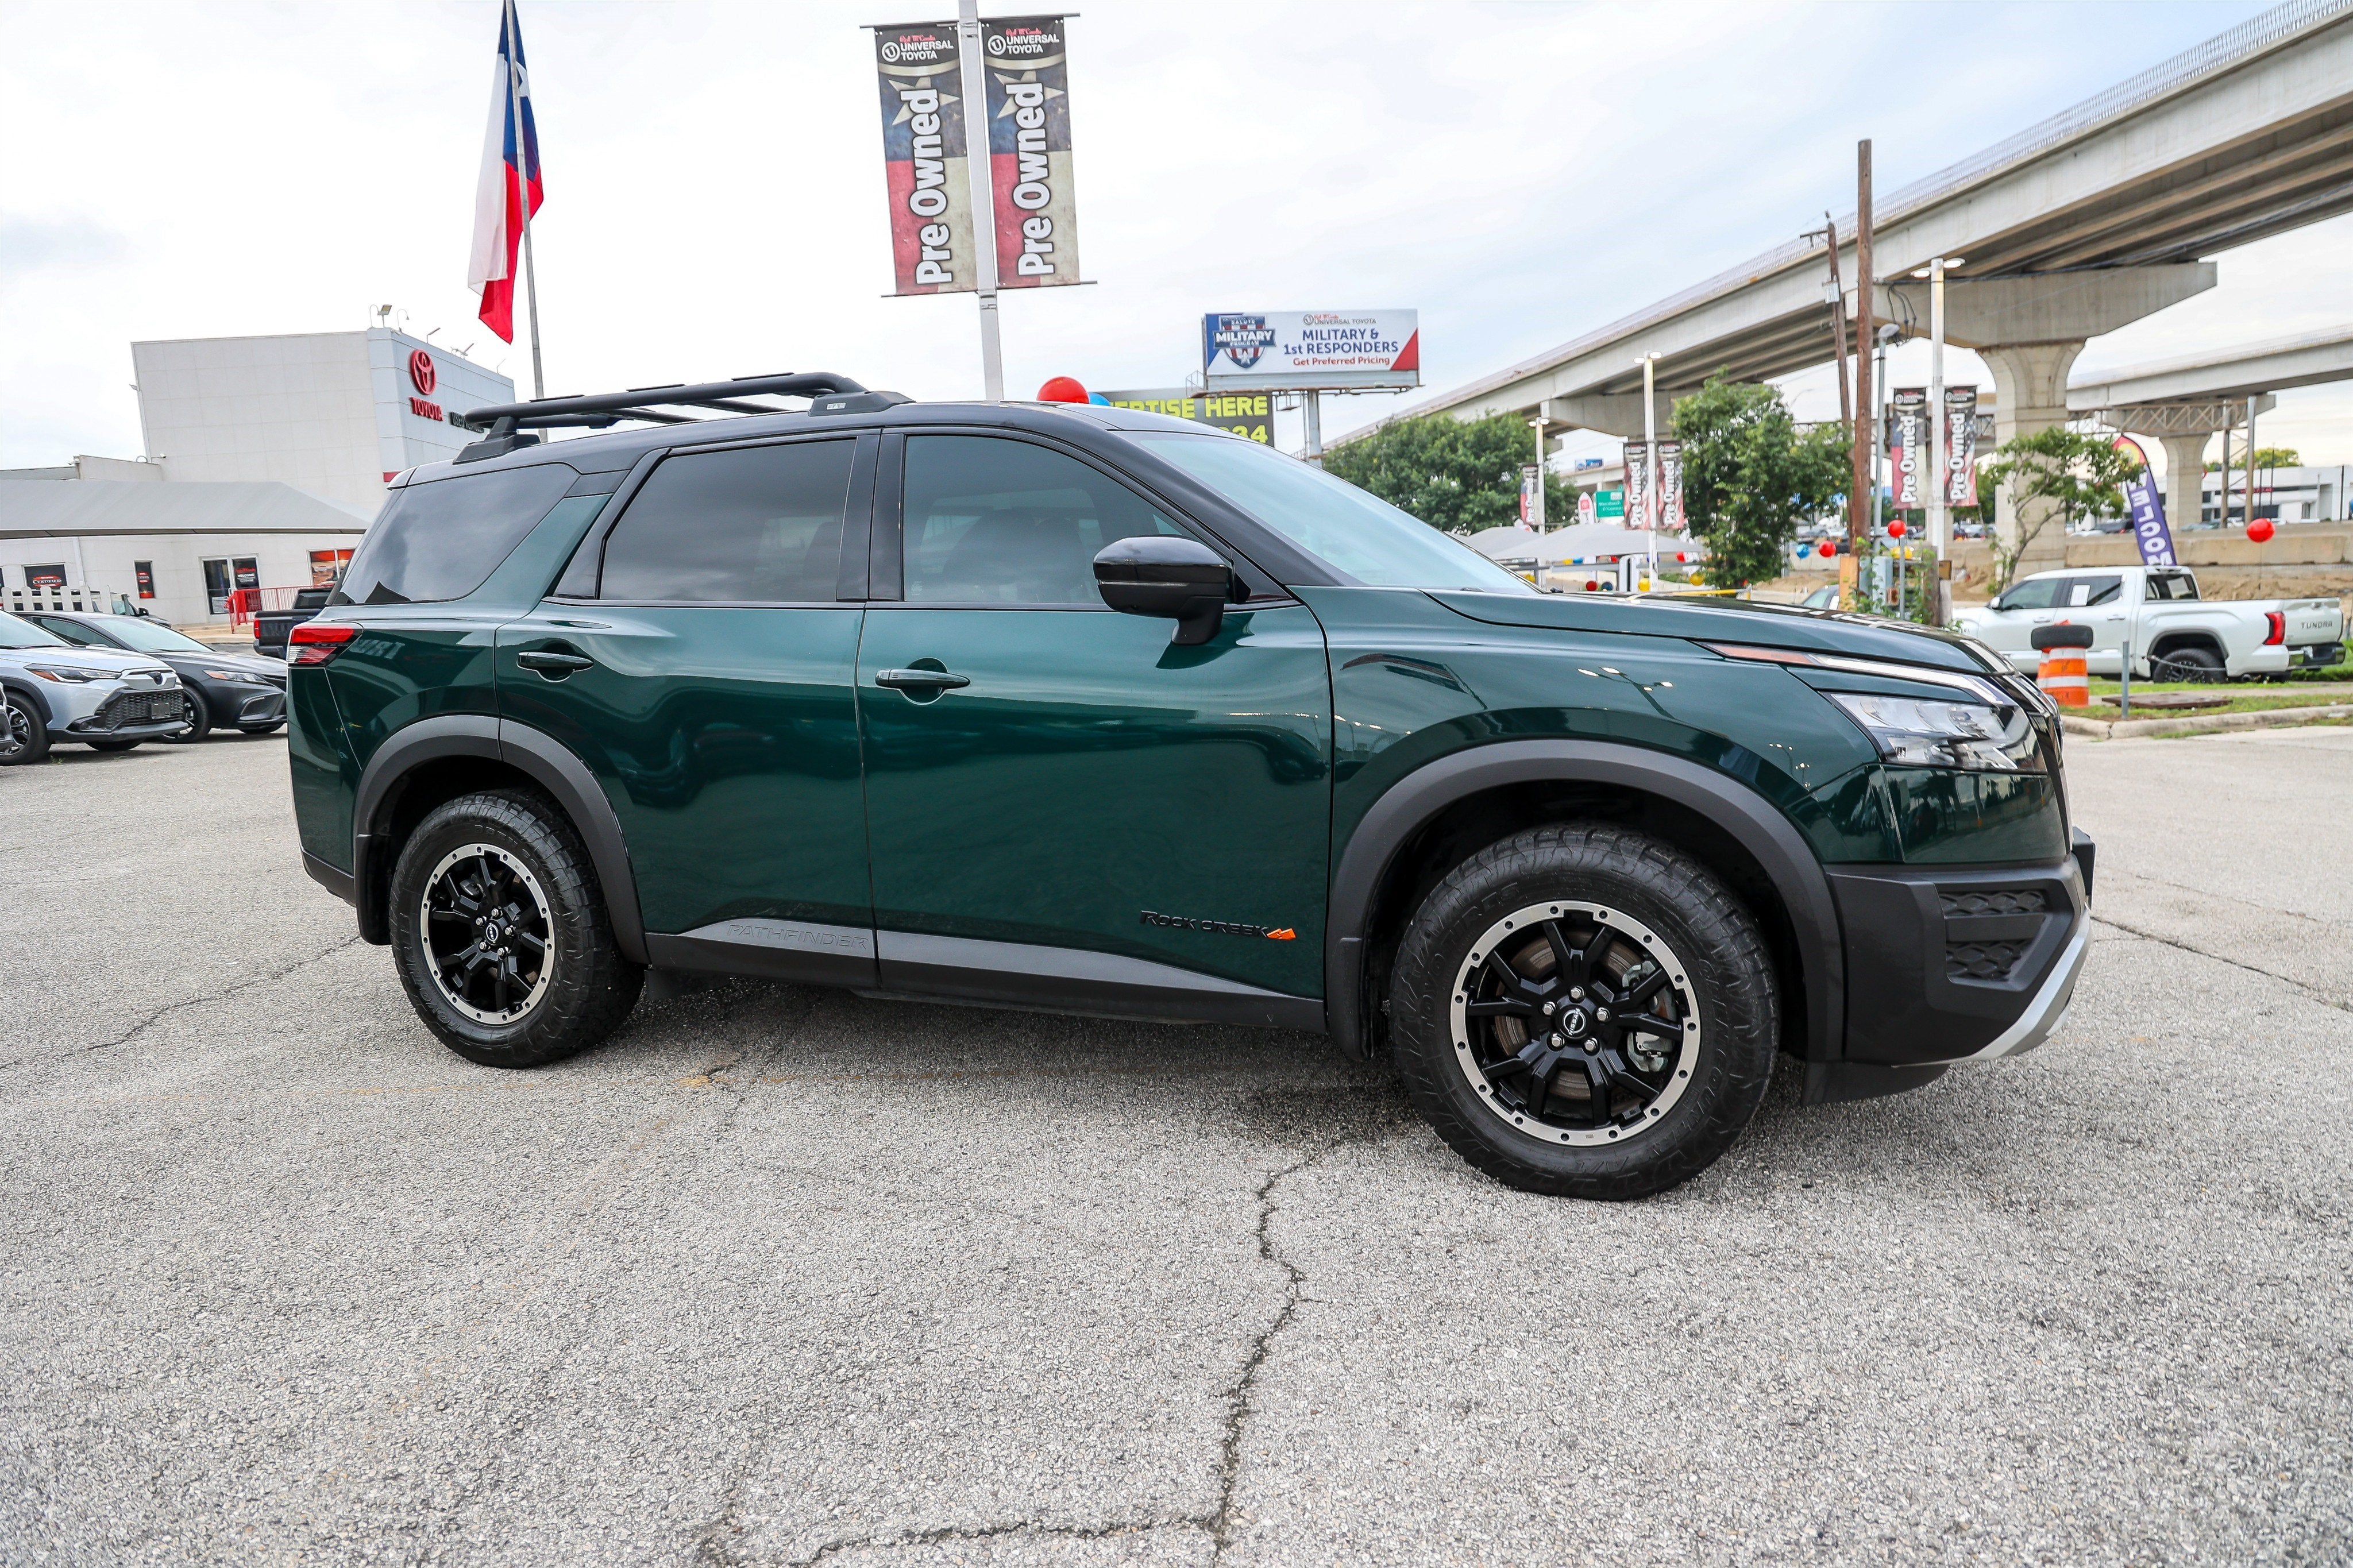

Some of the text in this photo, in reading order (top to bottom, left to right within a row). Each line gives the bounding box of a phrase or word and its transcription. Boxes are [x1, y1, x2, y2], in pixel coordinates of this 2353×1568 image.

[900, 40, 954, 52] UNIVERSAL
[1006, 33, 1060, 45] UNIVERSAL
[1006, 44, 1043, 55] TOYOTA
[901, 50, 938, 60] TOYOTA
[900, 88, 948, 217] Owned
[1005, 82, 1051, 210] Owned
[915, 223, 953, 284] Pre
[1018, 216, 1055, 276] Pre
[1216, 330, 1272, 343] MILITARY
[1302, 327, 1379, 341] MILITARY &
[1284, 341, 1398, 354] 1st RESPONDERS
[1293, 355, 1390, 366] Get Preferred Pricing
[410, 396, 443, 422] TOYOTA
[1205, 395, 1268, 418] HERE
[1899, 415, 1916, 473] Owned
[1949, 412, 1965, 470] Owned
[1629, 461, 1642, 505] Owned
[1662, 460, 1675, 504] Owned
[1900, 473, 1917, 503] Pre
[1950, 472, 1966, 500] Pre
[1630, 505, 1642, 526] Pre
[1663, 503, 1676, 524] Pre
[2301, 620, 2332, 629] TUNDRA
[727, 924, 869, 950] PATHFINDER
[1140, 910, 1270, 938] ROCK CREEK
[1568, 1007, 1581, 1036] NISSAN
